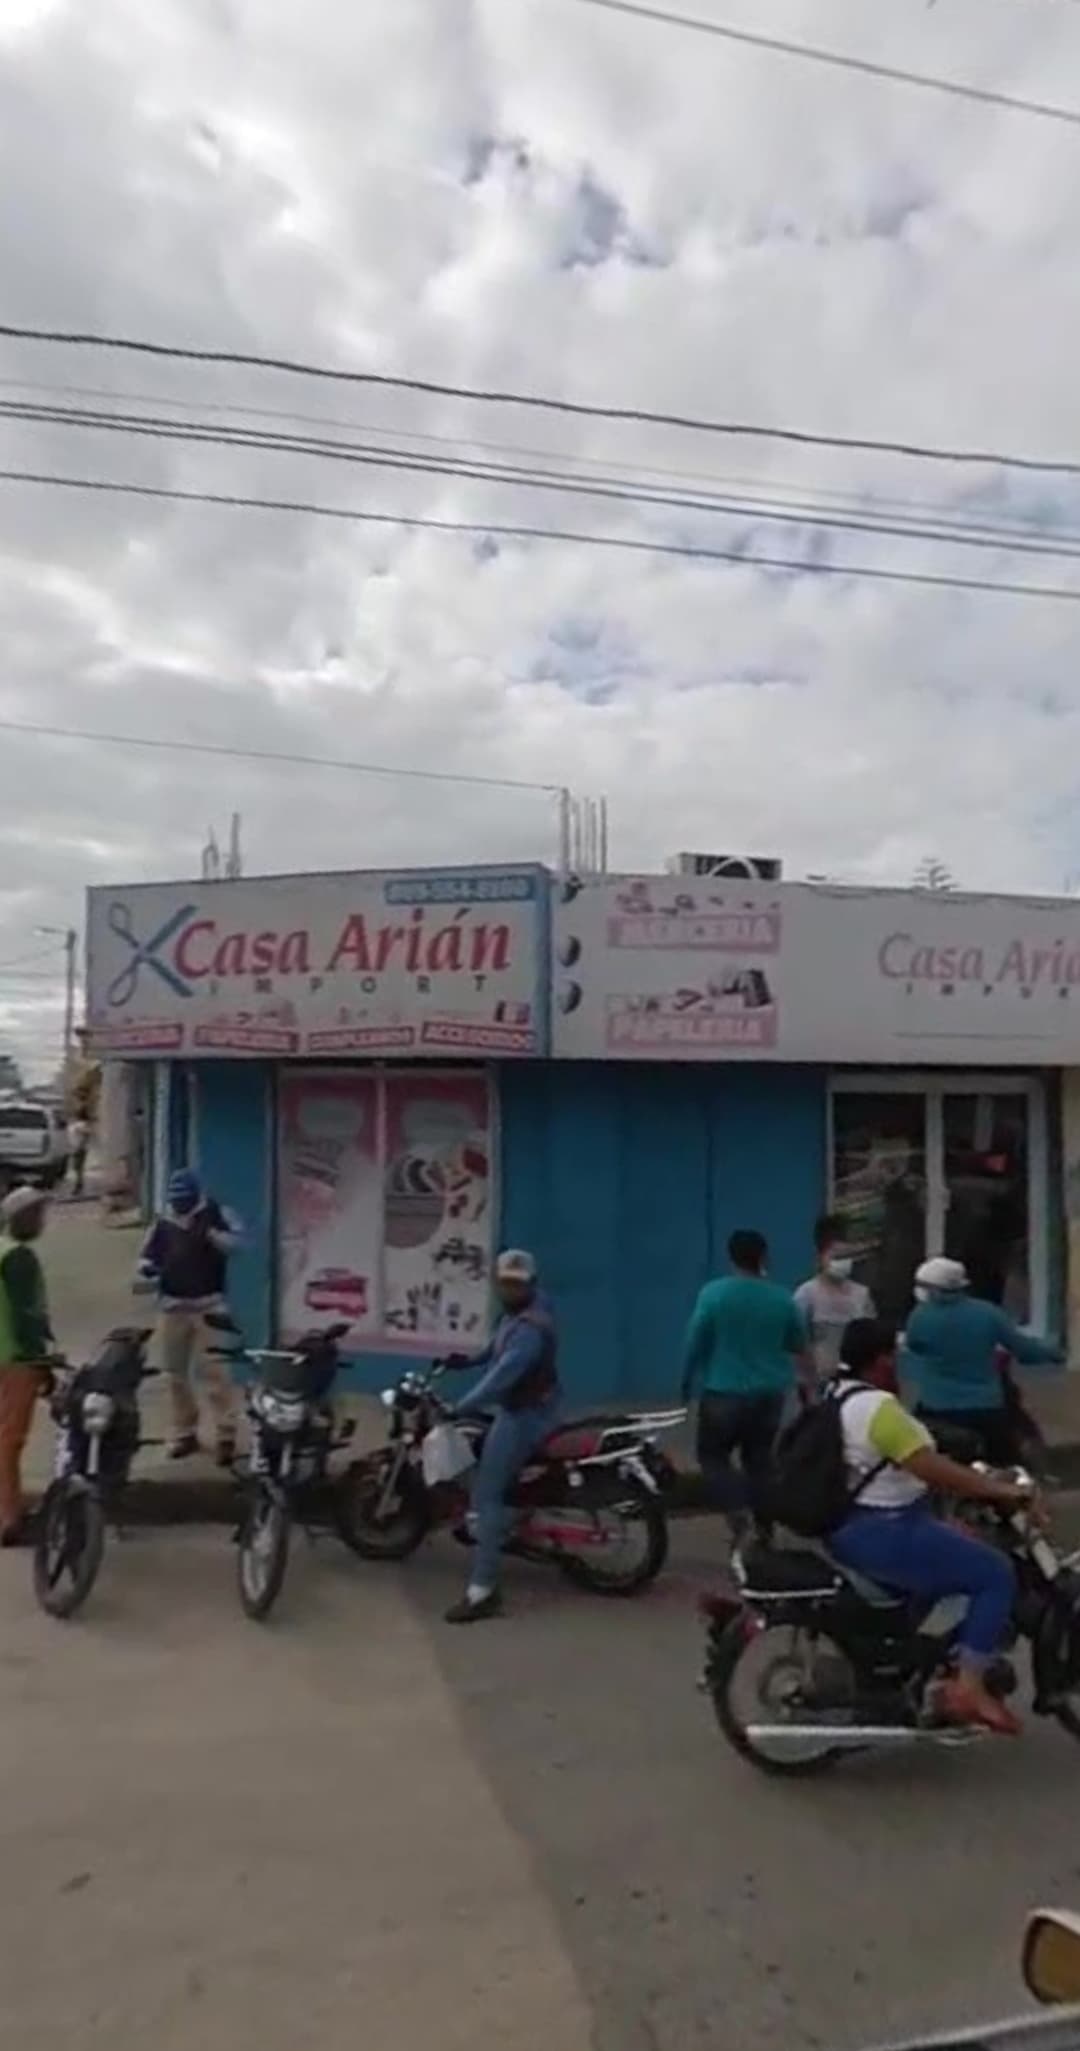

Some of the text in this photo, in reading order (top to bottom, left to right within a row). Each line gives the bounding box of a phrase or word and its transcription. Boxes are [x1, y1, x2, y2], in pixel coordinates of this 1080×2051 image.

[174, 907, 511, 979] Casa Arián
[878, 932, 984, 980] Casa
[209, 974, 488, 995] IMPORT
